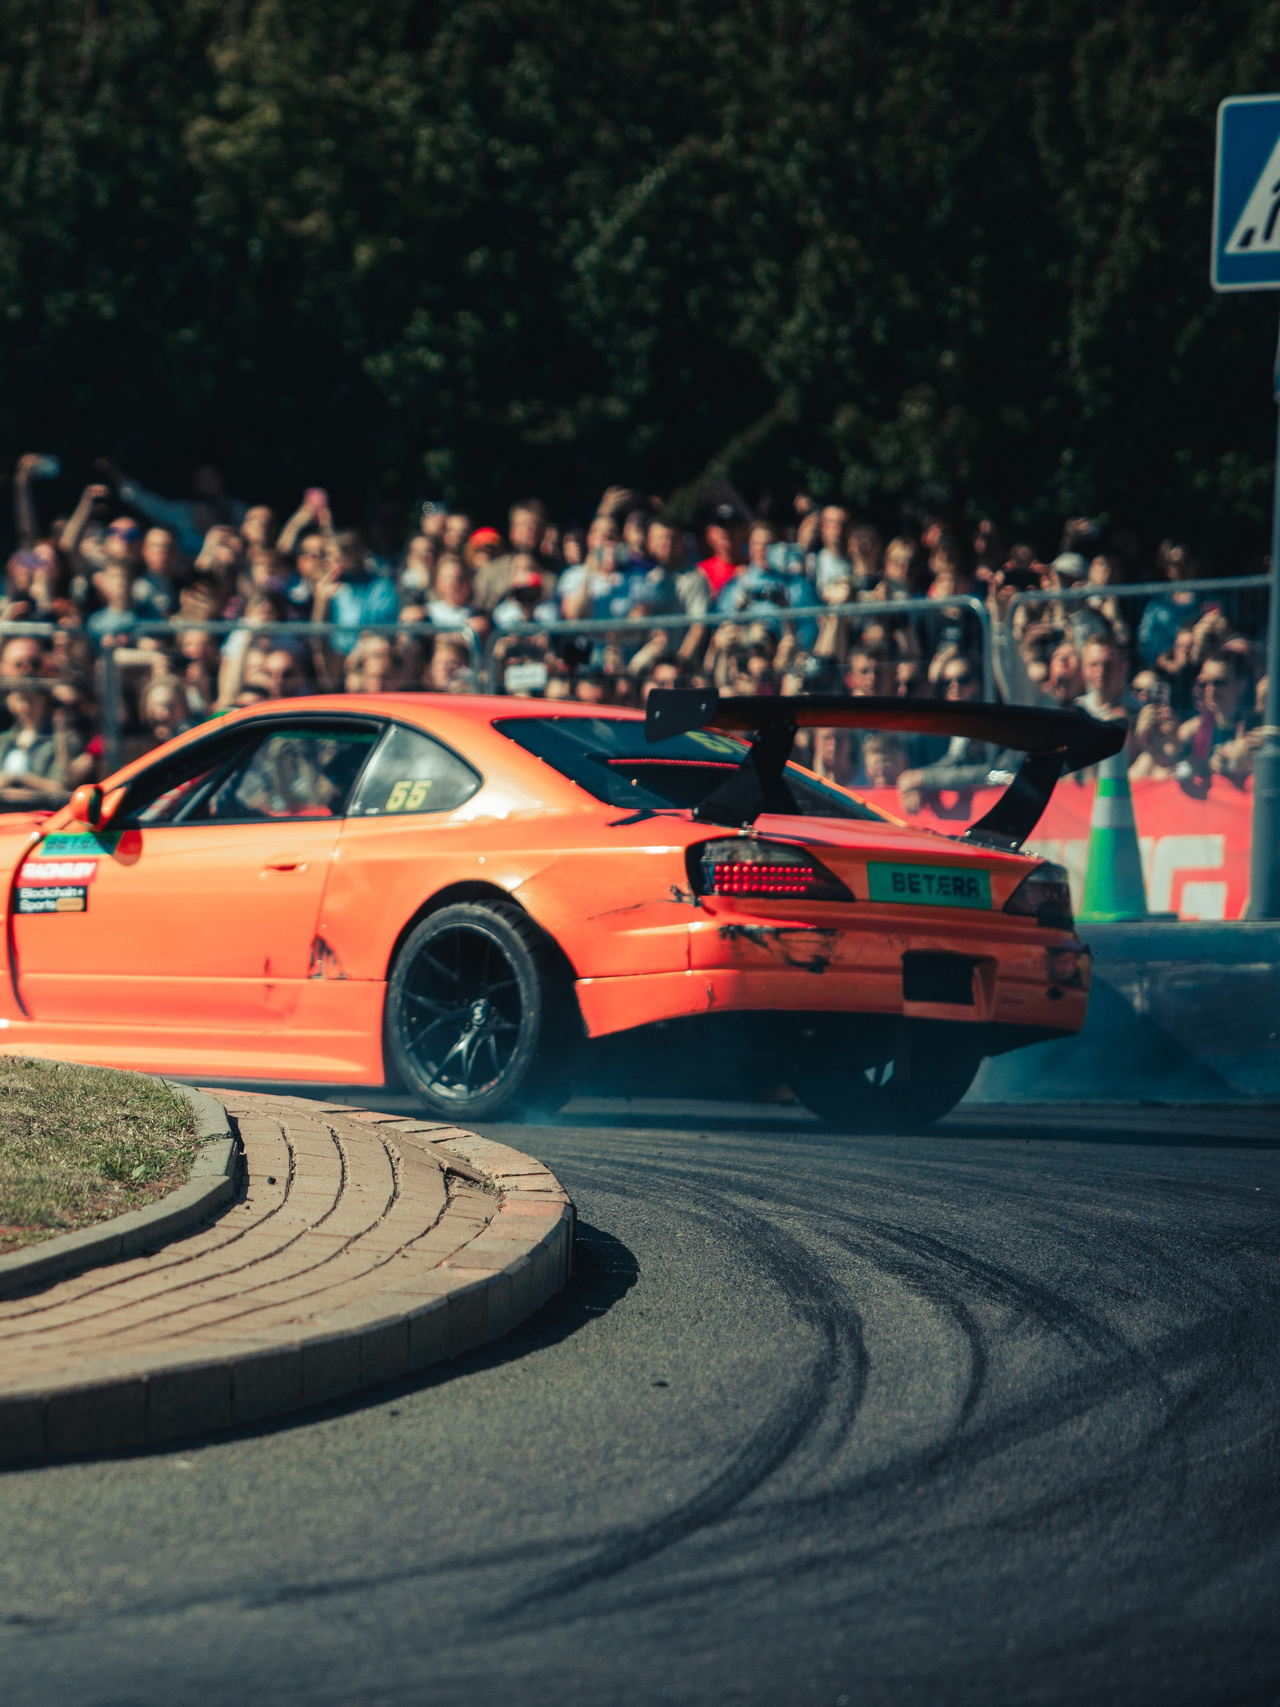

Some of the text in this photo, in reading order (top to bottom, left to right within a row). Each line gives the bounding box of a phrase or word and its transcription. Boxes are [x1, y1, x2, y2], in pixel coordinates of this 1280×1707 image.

[385, 780, 433, 812] 55
[20, 887, 78, 899] Blockchain
[20, 899, 57, 912] Sports
